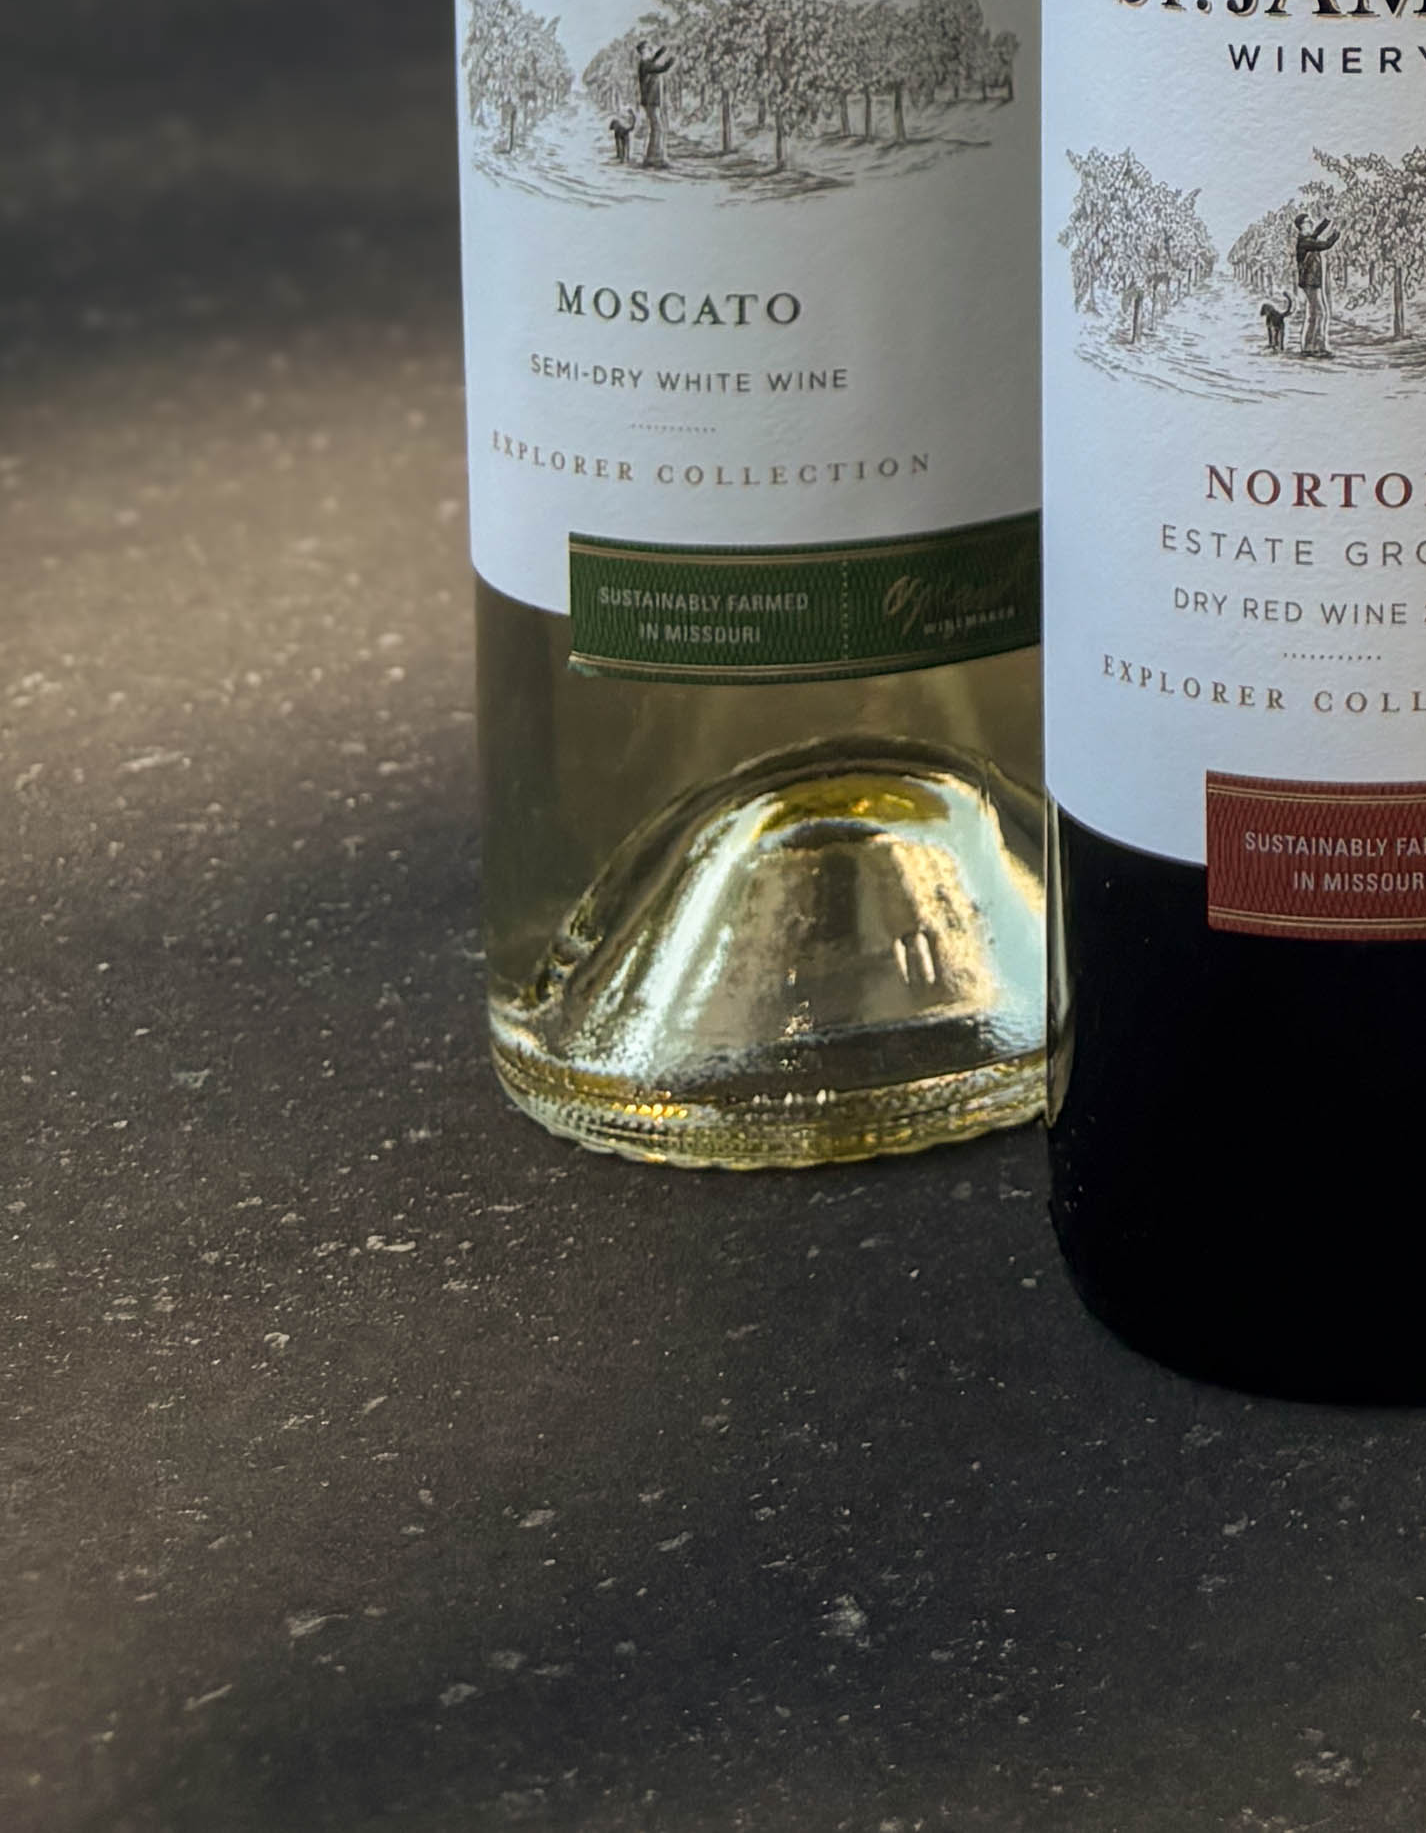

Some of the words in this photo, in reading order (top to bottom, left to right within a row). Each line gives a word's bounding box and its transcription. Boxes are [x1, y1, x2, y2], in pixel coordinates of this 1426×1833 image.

[556, 281, 801, 325] MOSCATO
[531, 354, 642, 389] SEMI-DRY
[656, 372, 751, 392] WHITE
[767, 369, 848, 392] WINE
[492, 430, 635, 481] EXPLORER
[656, 453, 930, 486] COLLECTION
[1162, 524, 1315, 566] ESTATE
[600, 587, 722, 612] SUSTAINABLY
[727, 592, 809, 611] FARMED
[1174, 588, 1228, 613] DRY
[1243, 599, 1302, 622] RED
[1321, 603, 1407, 625] WINE
[639, 624, 659, 639] IN
[664, 624, 761, 643] MISSOURI
[1103, 654, 1286, 710] EXPLORER
[1244, 832, 1386, 858] SUSTAINABLY
[1293, 872, 1314, 891] IN
